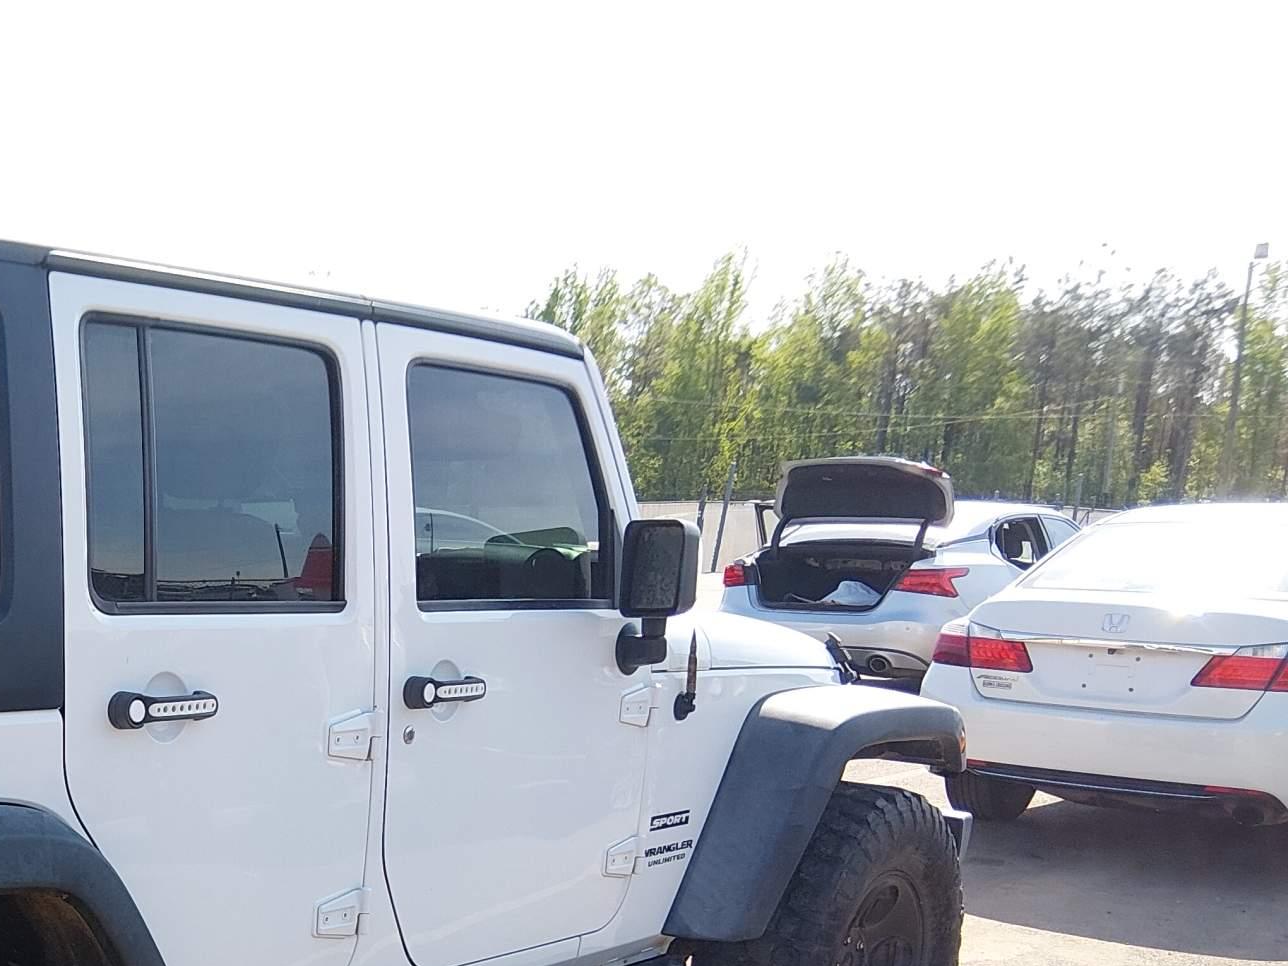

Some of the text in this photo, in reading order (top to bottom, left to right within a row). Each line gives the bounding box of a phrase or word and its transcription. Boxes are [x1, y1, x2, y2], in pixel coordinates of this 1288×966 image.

[651, 814, 689, 829] SPORT
[644, 839, 693, 858] WRANGLER
[647, 852, 686, 867] UNLIMITED
